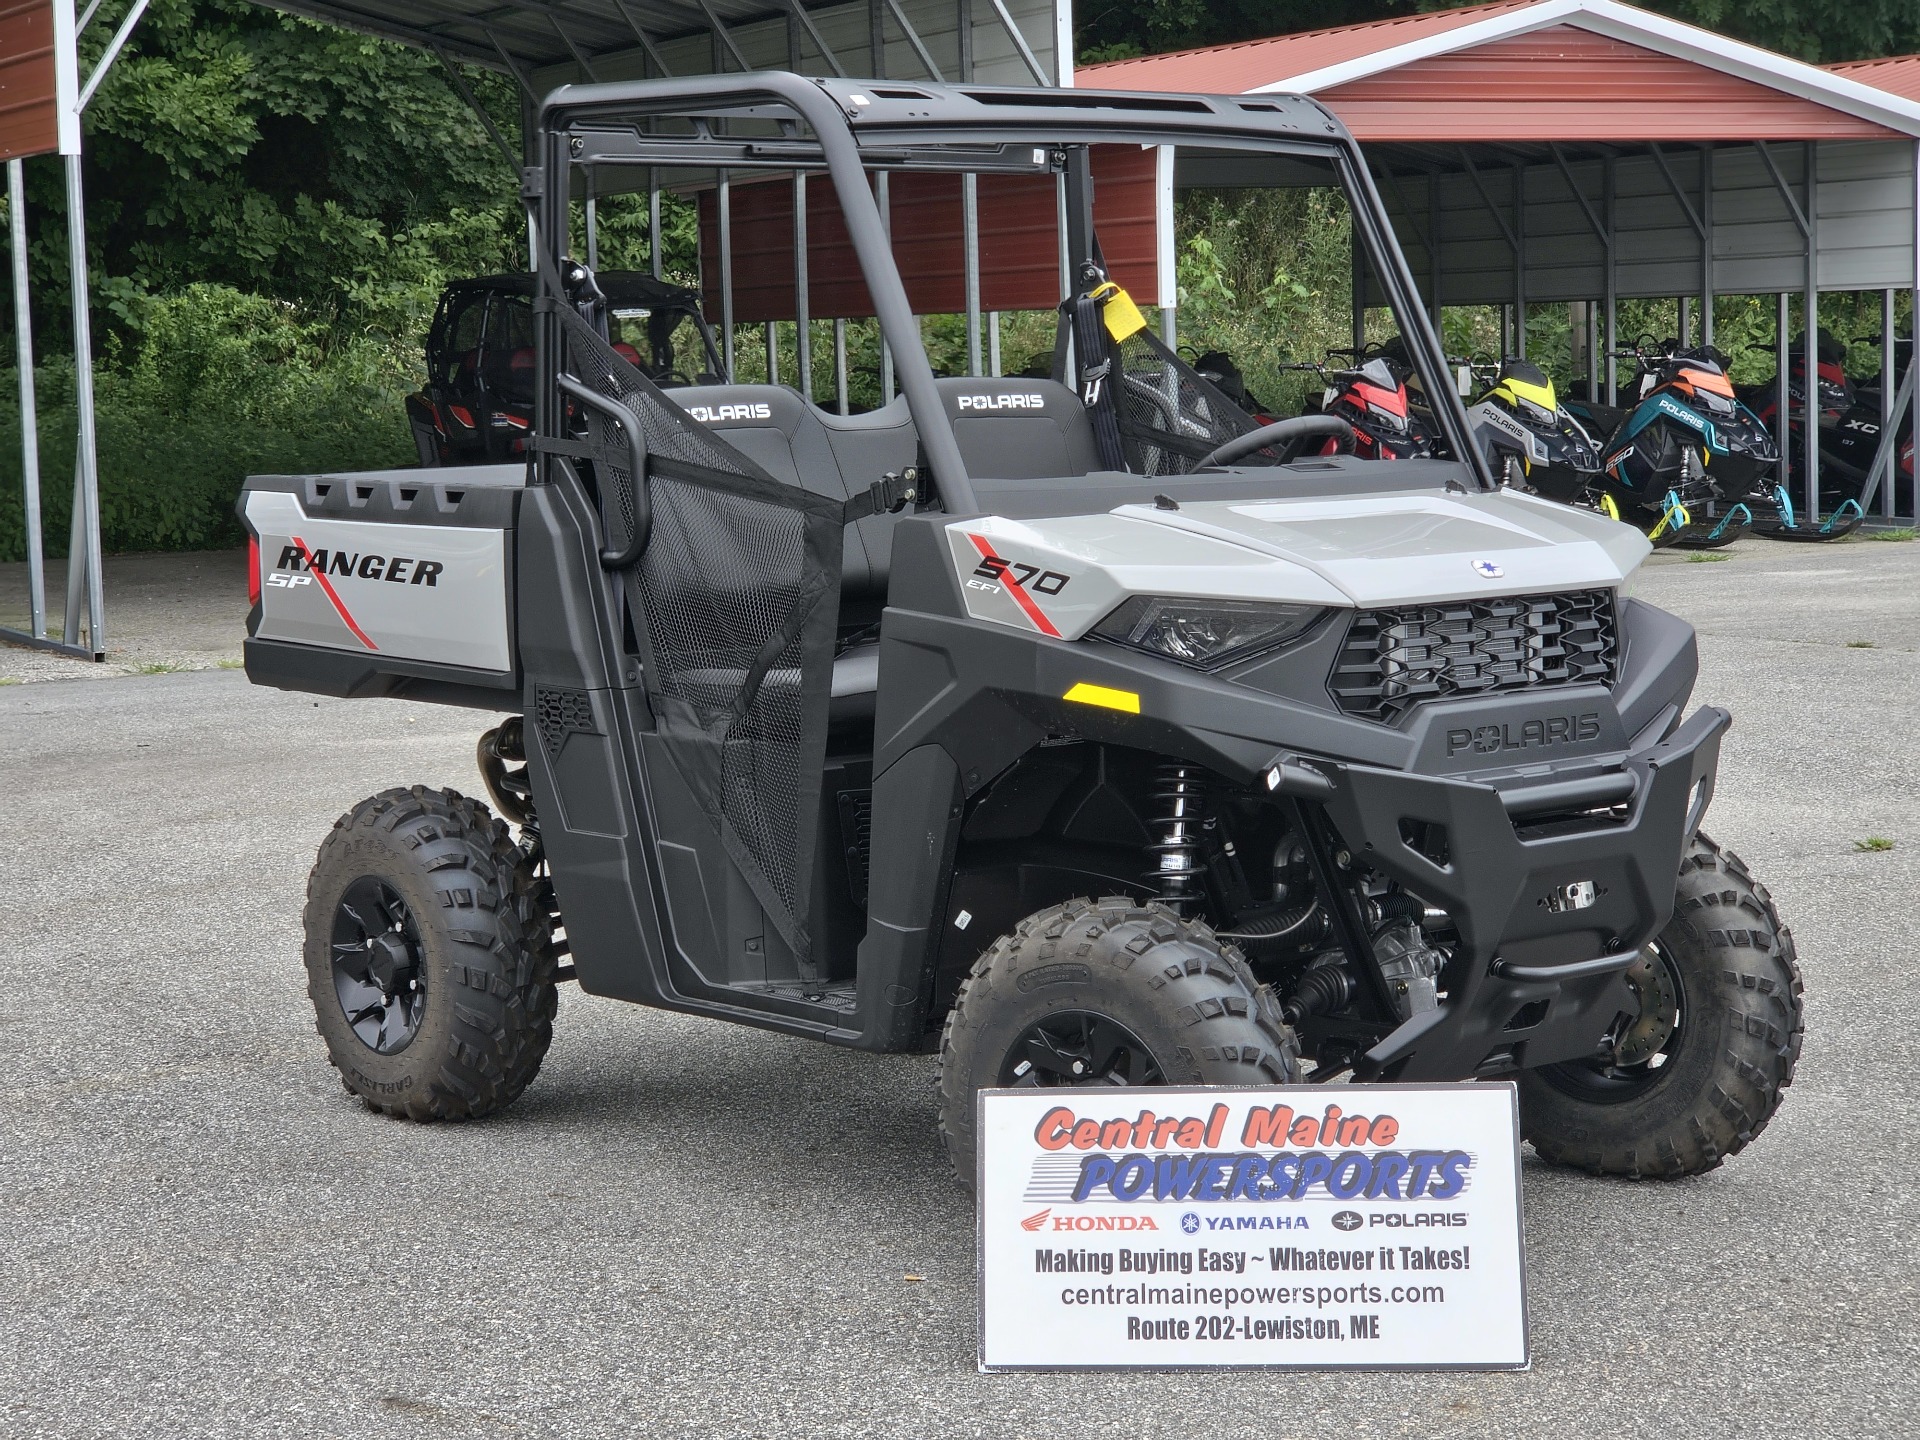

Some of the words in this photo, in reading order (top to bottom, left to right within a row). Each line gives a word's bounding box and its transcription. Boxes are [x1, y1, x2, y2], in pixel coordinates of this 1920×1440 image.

[957, 394, 1045, 410] POLARIS
[1658, 399, 1705, 429] POLARIS
[1482, 408, 1525, 437] POLARIS
[1844, 419, 1880, 434] XC
[1605, 445, 1635, 473] 650
[276, 545, 444, 587] RANGER
[973, 555, 1071, 596] 570
[266, 572, 313, 589] SP
[966, 579, 1001, 594] EFI
[1447, 712, 1600, 758] POLARIS
[1034, 1103, 1230, 1151] Central
[1241, 1103, 1399, 1148] Maine
[1071, 1150, 1472, 1202] POWERSPORTS
[1052, 1216, 1159, 1231] HONDA
[1205, 1216, 1310, 1230] YAMAHA
[1370, 1213, 1468, 1228] POLARIS
[1035, 1249, 1114, 1275] Making
[1119, 1248, 1193, 1275] Buying
[1198, 1248, 1247, 1274] Easy
[1269, 1247, 1375, 1271] Whatever
[1380, 1246, 1395, 1270] it
[1399, 1246, 1470, 1270] Takes!
[1061, 1282, 1445, 1309] centralmainepowersports.com
[1127, 1316, 1190, 1340] Route
[1195, 1315, 1345, 1341] 202-Lewiston,
[1350, 1315, 1381, 1339] ME
